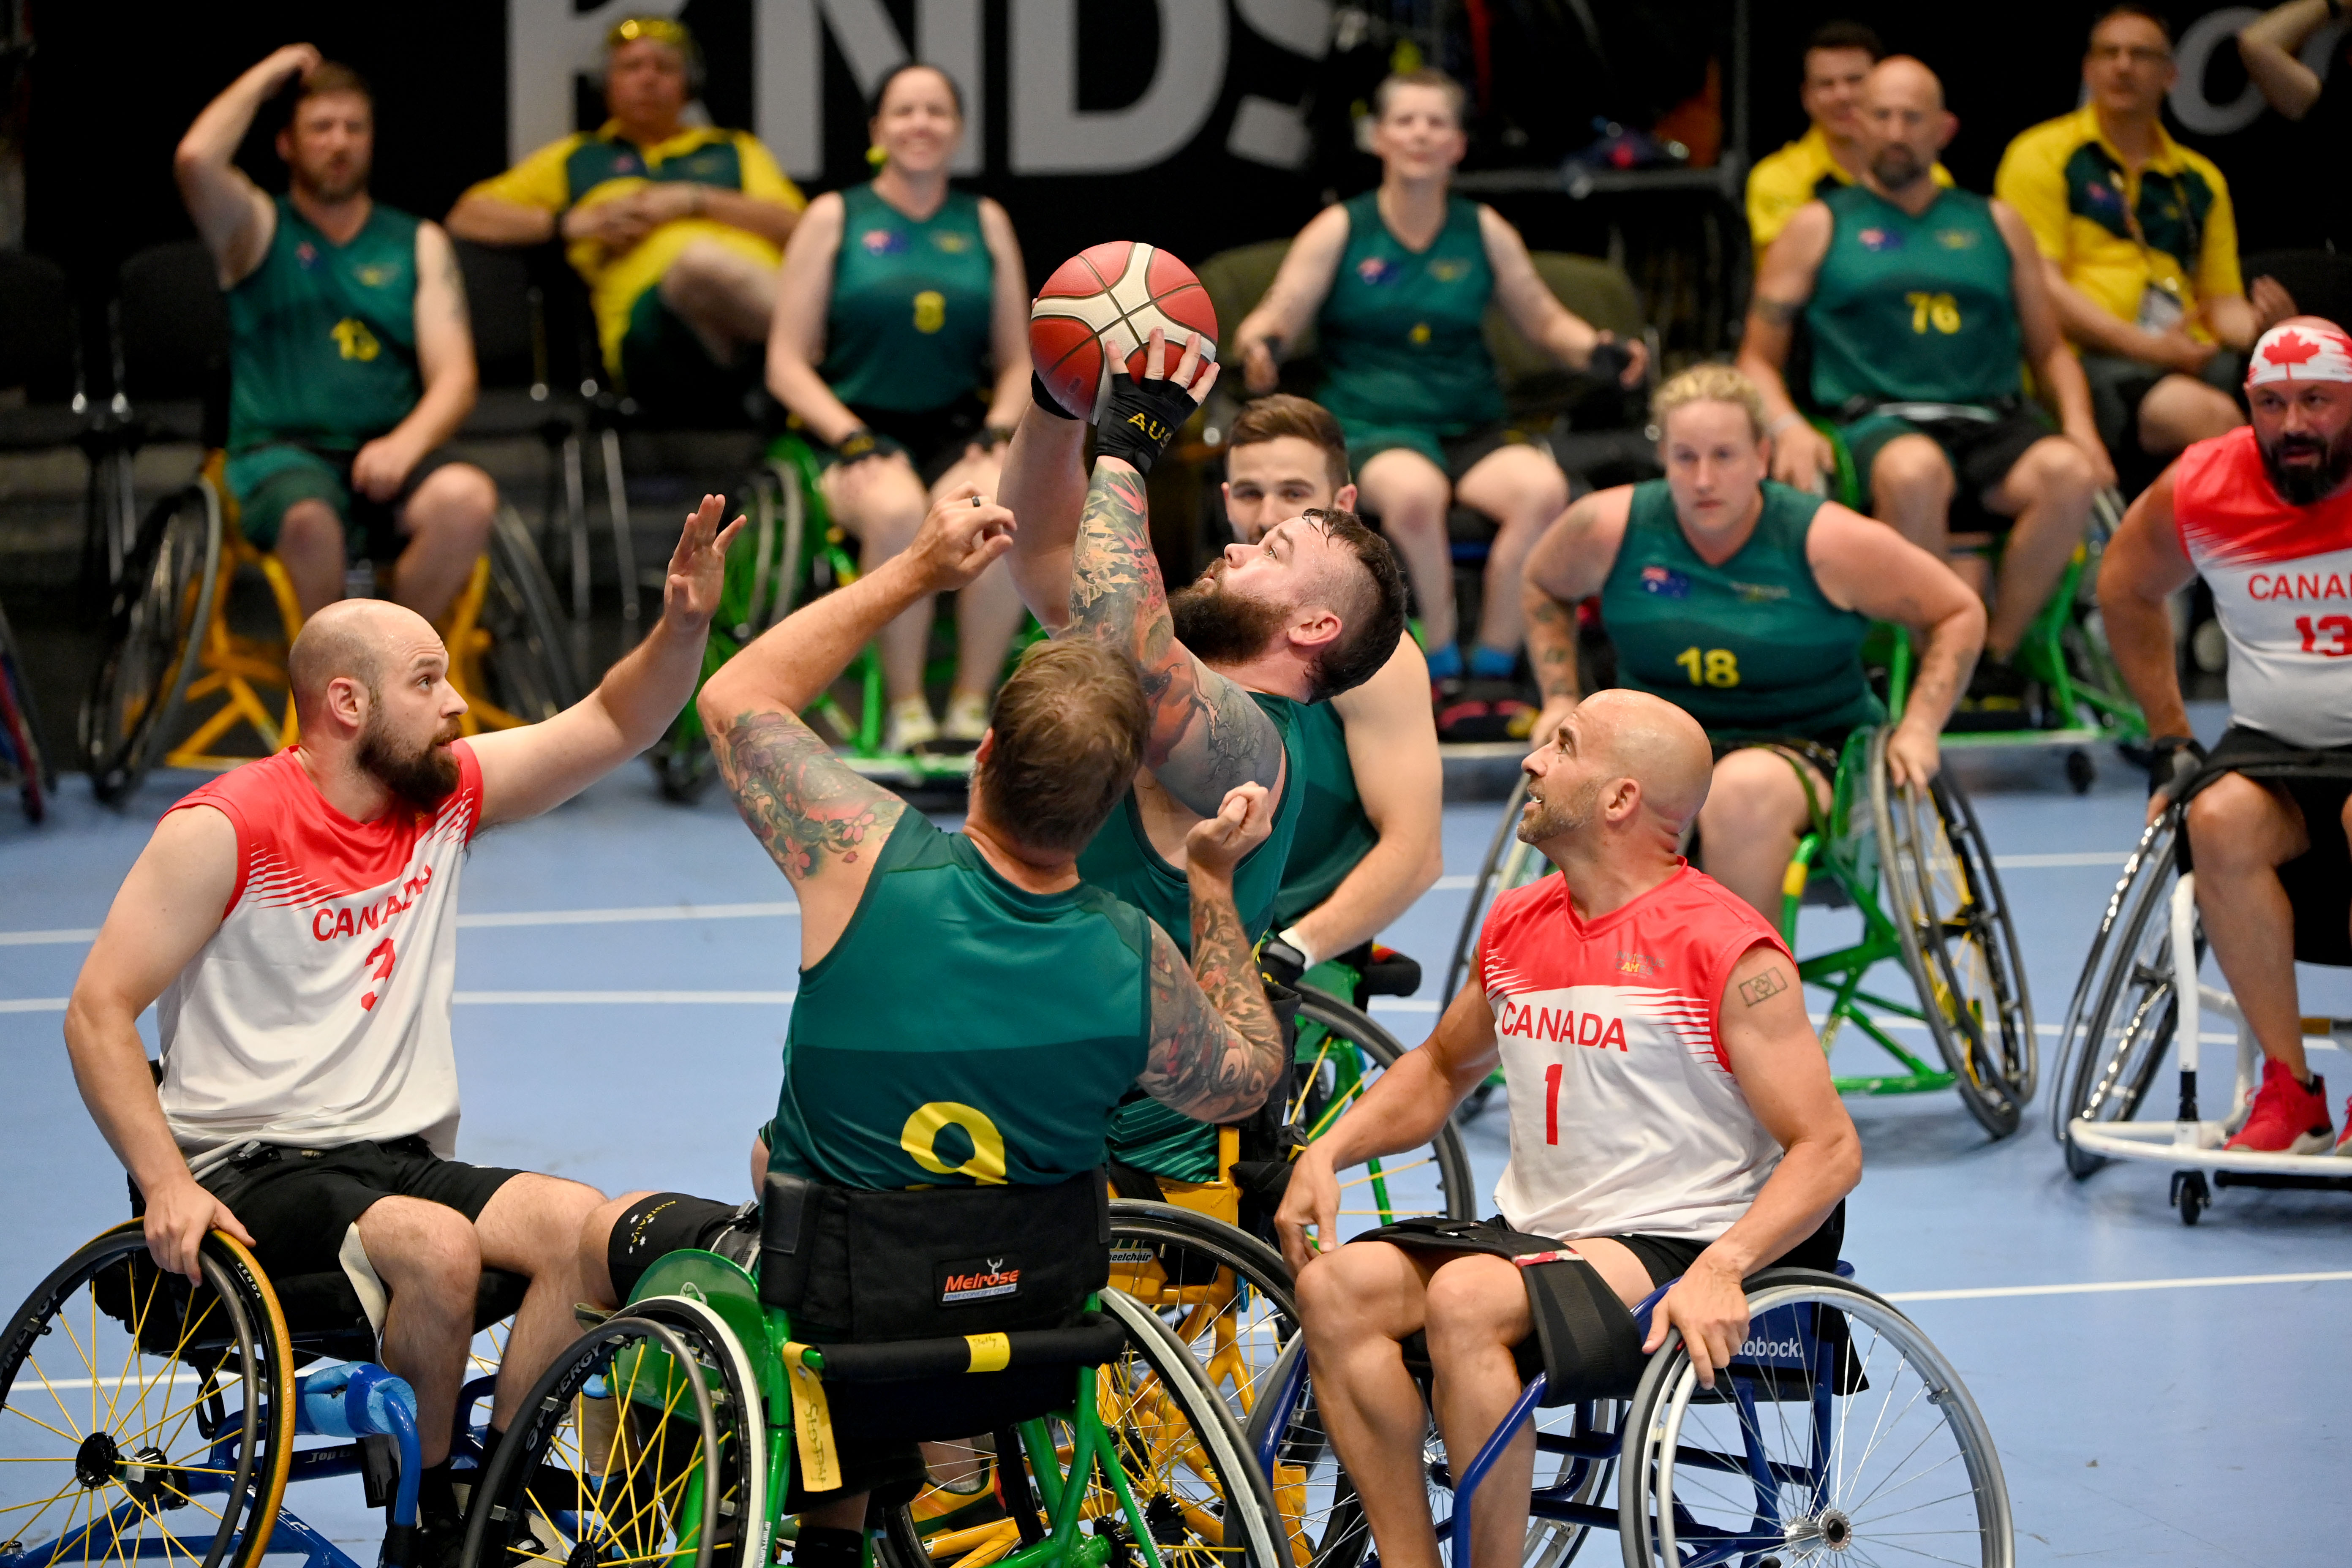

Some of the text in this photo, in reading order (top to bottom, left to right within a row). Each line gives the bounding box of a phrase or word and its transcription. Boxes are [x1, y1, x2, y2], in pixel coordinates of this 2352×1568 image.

[1904, 291, 1961, 334] 76
[2248, 572, 2352, 602] CANA
[1676, 646, 1741, 689] 18
[1615, 961, 1654, 975] GAMES
[1502, 1001, 1628, 1052] CANADA
[1545, 1063, 1563, 1146] 1
[632, 1200, 677, 1244] AUSTRALIA
[237, 1262, 261, 1299] KENDA
[945, 1269, 1020, 1292] Melrose
[304, 1451, 336, 1464] Top
